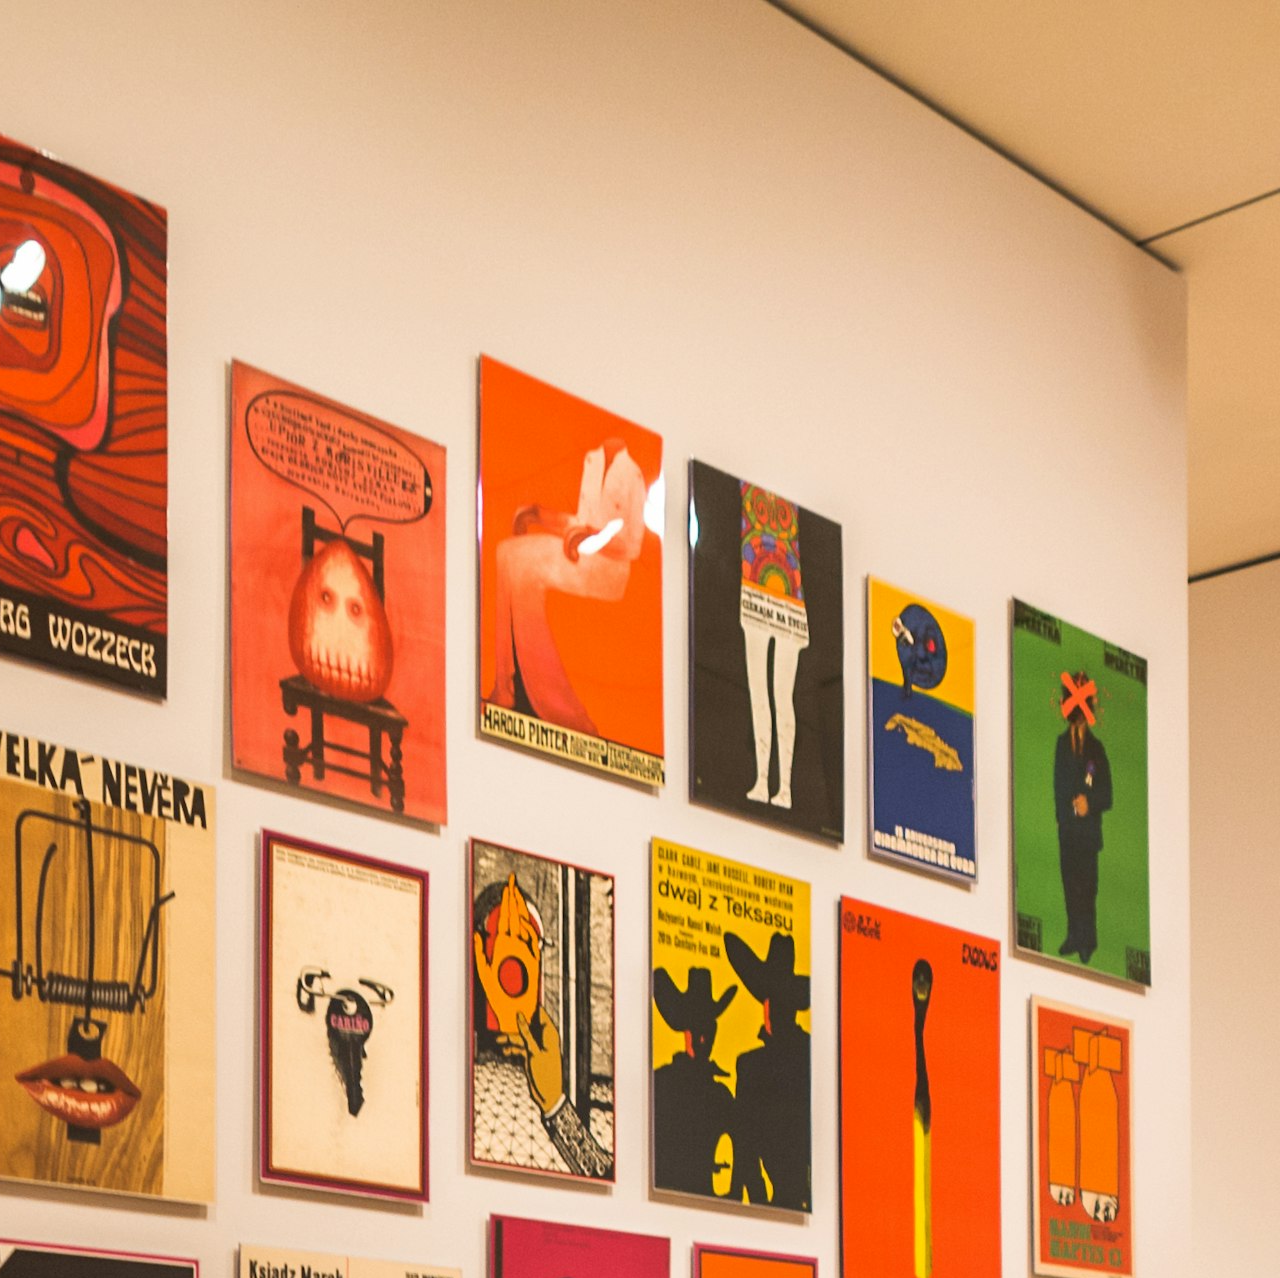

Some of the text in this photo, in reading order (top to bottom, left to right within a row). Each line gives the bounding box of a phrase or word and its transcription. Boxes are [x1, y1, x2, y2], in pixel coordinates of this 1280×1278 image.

[47, 613, 157, 678] WOZZECK
[483, 707, 526, 740] HAROLD
[528, 720, 569, 754] PINTER
[101, 756, 207, 830] NEVĚRA
[658, 879, 793, 932] dwaj z Teksasu
[330, 1012, 370, 1033] CARIÑO
